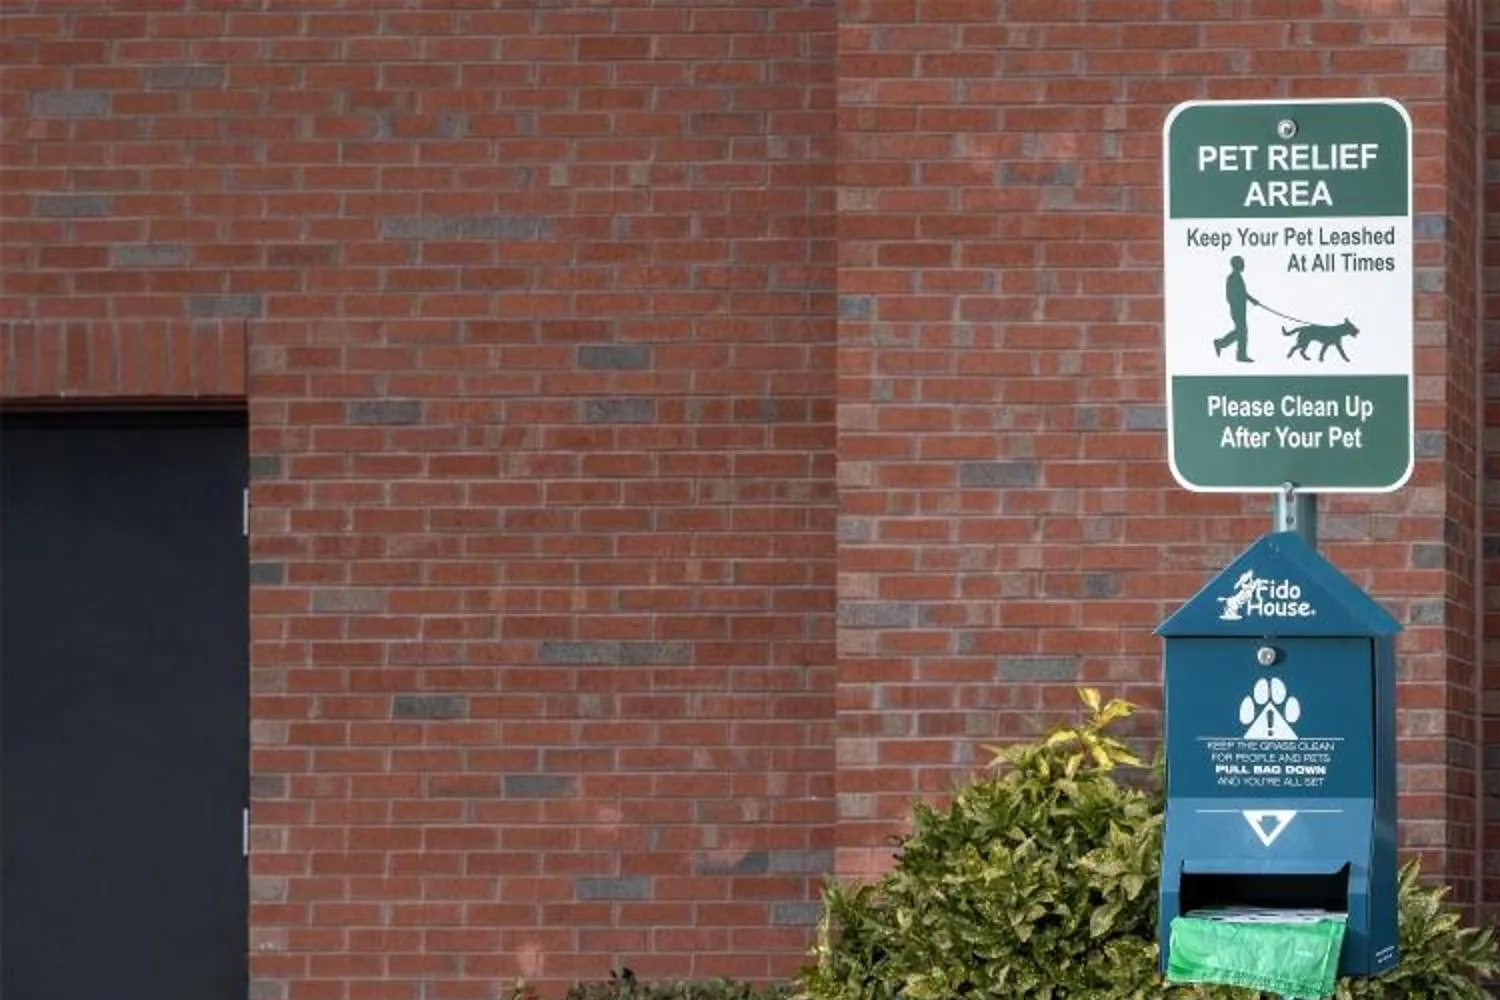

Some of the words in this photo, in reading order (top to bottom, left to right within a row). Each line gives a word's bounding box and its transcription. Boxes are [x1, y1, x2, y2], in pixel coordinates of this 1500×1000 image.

[1198, 145, 1258, 171] PET
[1267, 143, 1379, 170] RELIEF
[1244, 180, 1333, 207] AREA
[1187, 228, 1232, 250] Keep
[1237, 228, 1279, 246] Your
[1284, 227, 1313, 246] Pet
[1319, 226, 1396, 246] Leashed
[1287, 253, 1307, 272] At
[1311, 253, 1335, 272] All
[1341, 253, 1396, 272] Times
[1207, 395, 1275, 417] Please
[1281, 395, 1339, 417] Clean
[1345, 395, 1374, 422] Up
[1220, 425, 1271, 448] After
[1275, 425, 1323, 448] Your
[1328, 426, 1363, 448] Pet
[1256, 578, 1301, 599] Fido
[1238, 741, 1258, 750] THE
[1236, 753, 1276, 762] PEOPLE
[1278, 753, 1301, 762] AND
[1215, 765, 1250, 774] PULL
[1285, 765, 1327, 774] DOWN
[1217, 777, 1241, 787] AND
[1283, 777, 1302, 787] ALL
